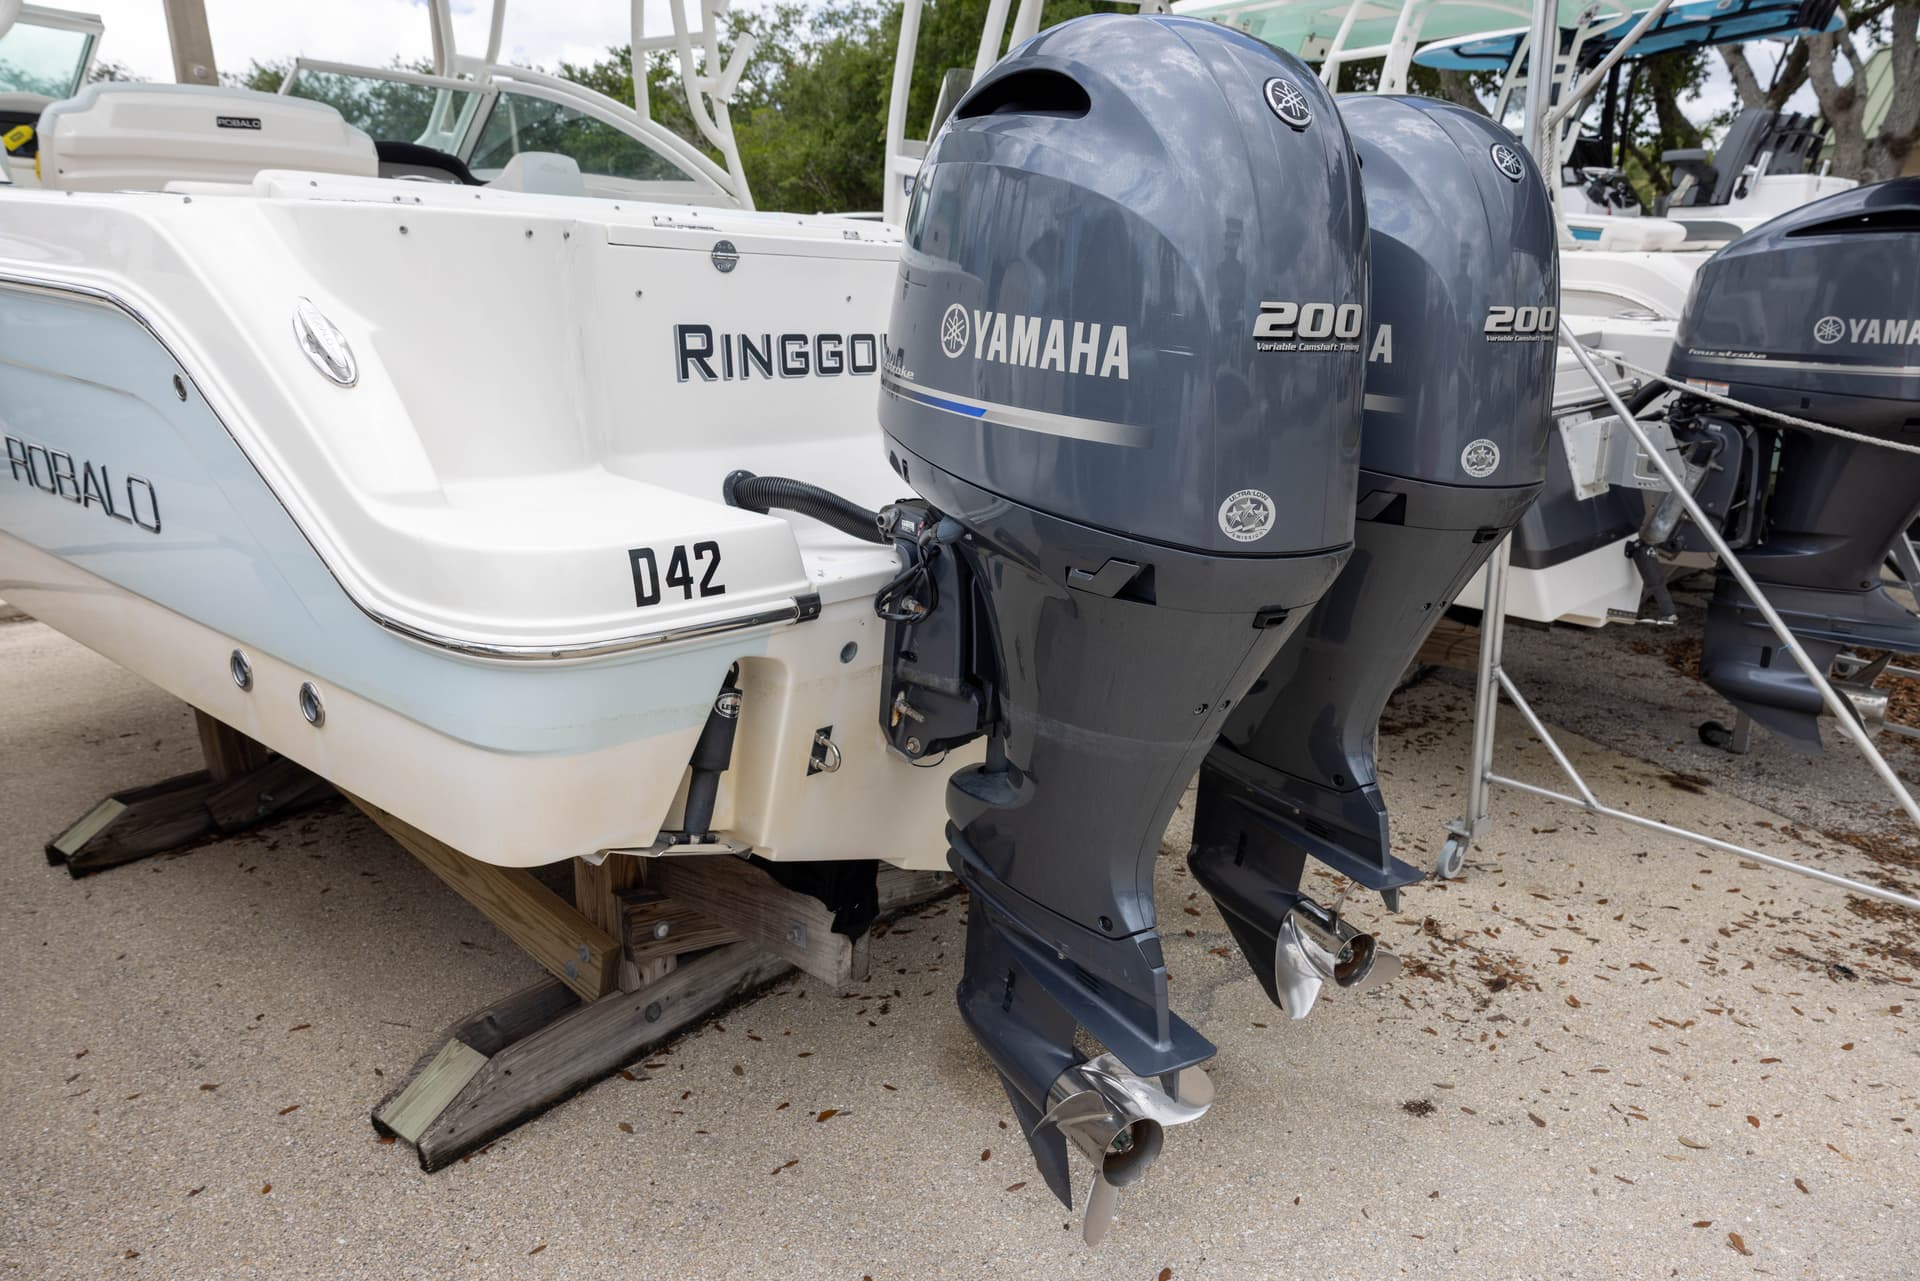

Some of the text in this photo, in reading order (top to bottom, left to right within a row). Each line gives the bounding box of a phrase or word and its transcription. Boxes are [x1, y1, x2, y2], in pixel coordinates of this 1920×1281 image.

[217, 119, 261, 128] ROBALO
[1252, 301, 1363, 339] 200
[1484, 306, 1556, 332] 200
[1849, 318, 1920, 345] YAMA
[673, 323, 888, 382] RINGGO
[973, 309, 1129, 380] YAMAHA
[1256, 343, 1297, 352] Variable
[1299, 343, 1338, 352] Camshaft
[5, 433, 161, 534] ROBALO
[1229, 490, 1269, 503] ULTRA LOW
[628, 540, 726, 607] D42
